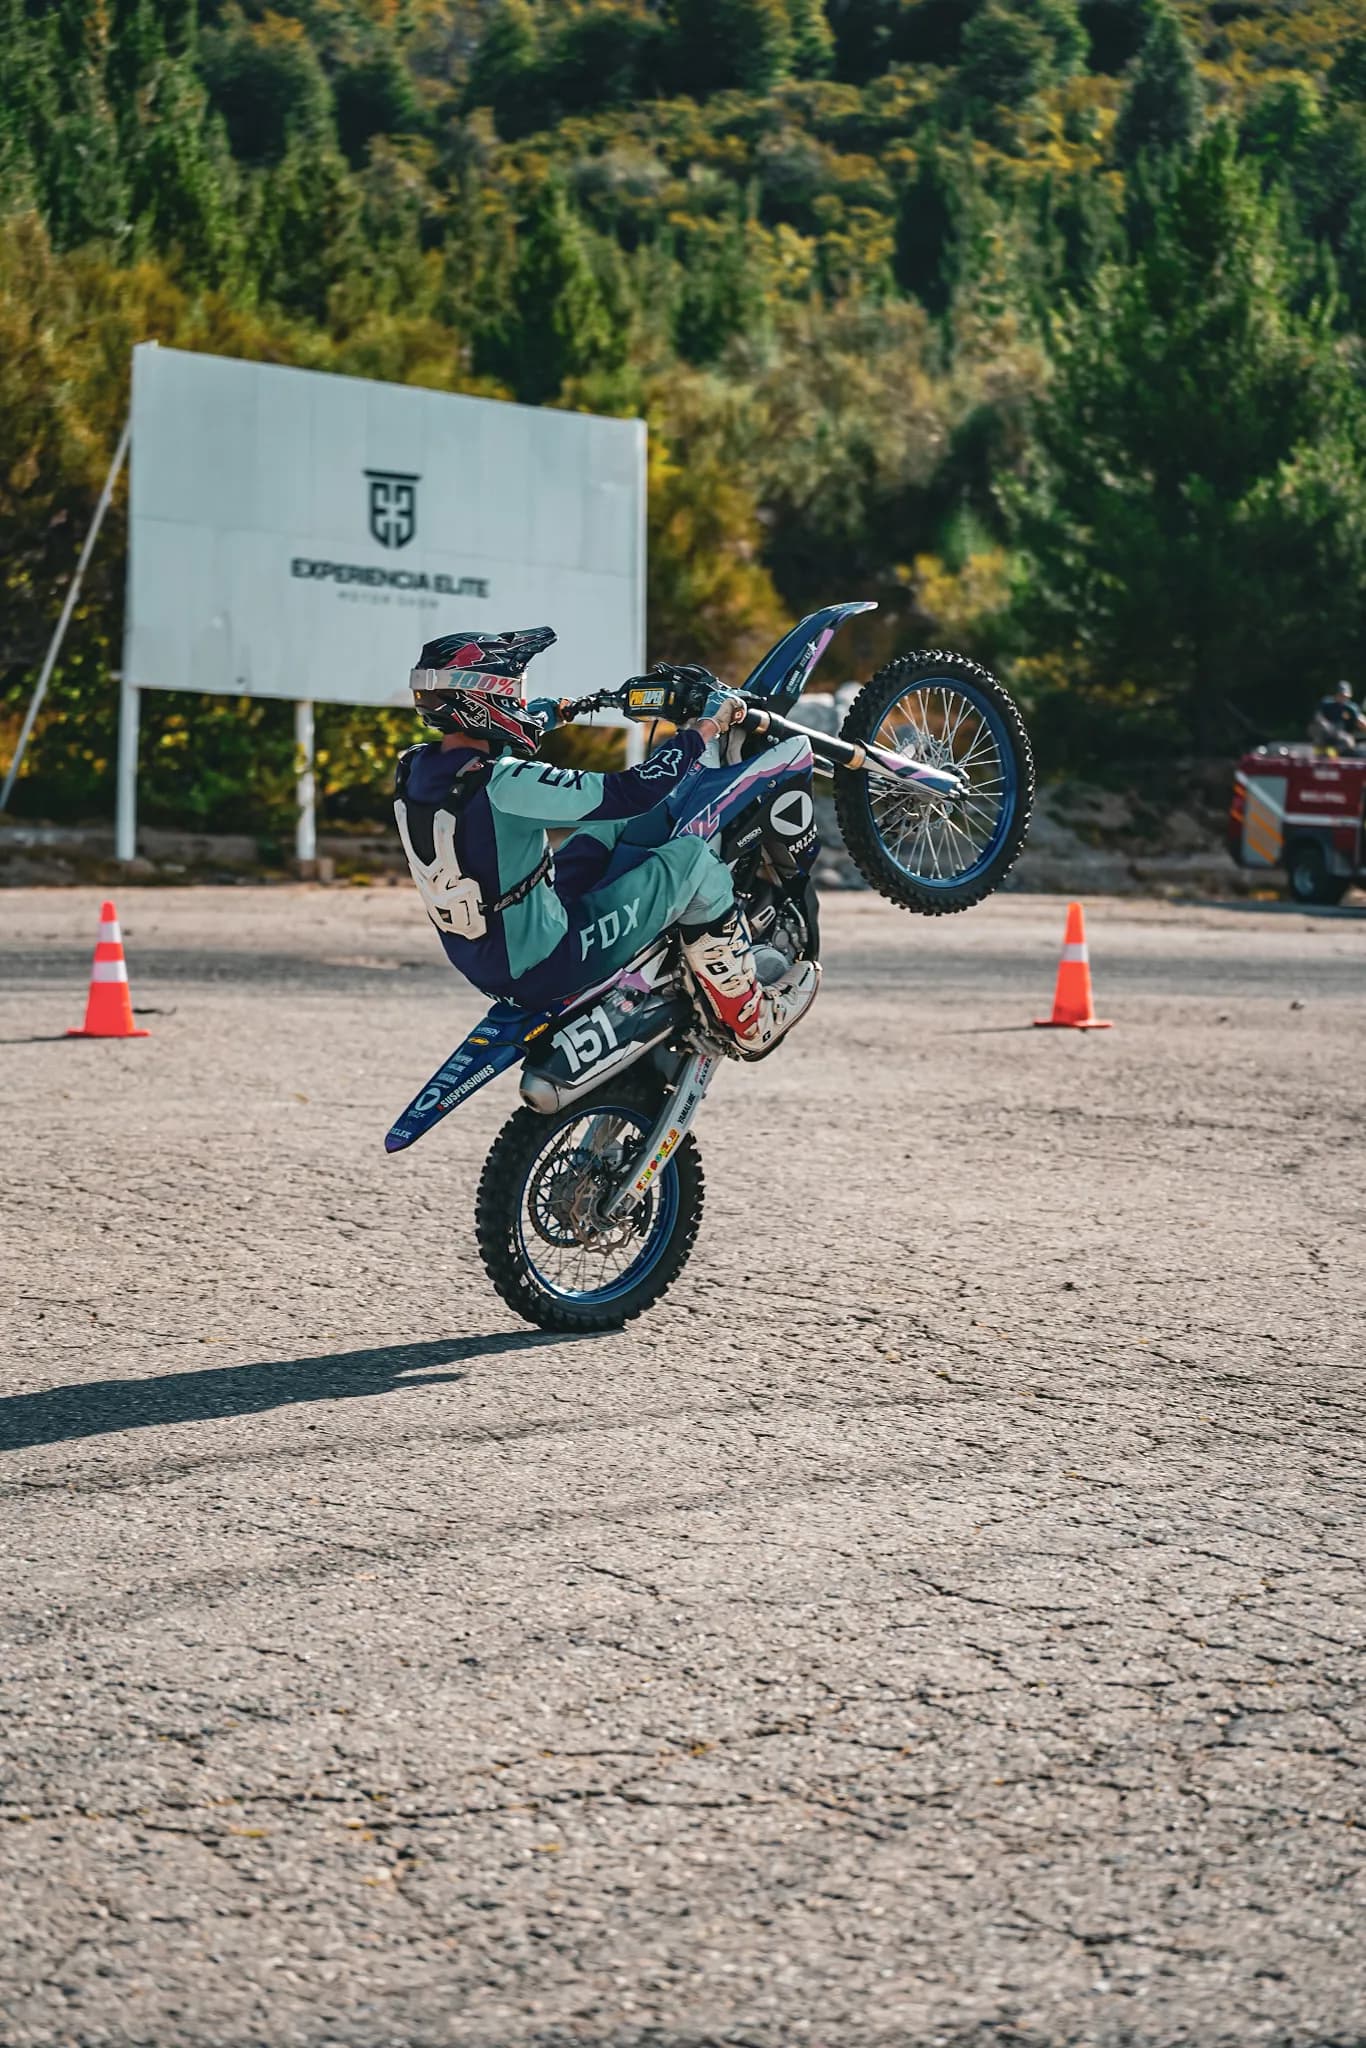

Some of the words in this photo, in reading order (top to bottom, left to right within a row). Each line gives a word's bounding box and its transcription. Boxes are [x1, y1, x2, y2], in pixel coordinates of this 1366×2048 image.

[291, 557, 430, 591] EXPERIENCIA
[433, 574, 490, 599] ELITE
[448, 671, 515, 696] 100%
[511, 760, 588, 790] FOX
[579, 897, 640, 961] FOX
[551, 1005, 619, 1074] 151
[440, 1064, 496, 1108] SUSPENSIONES
